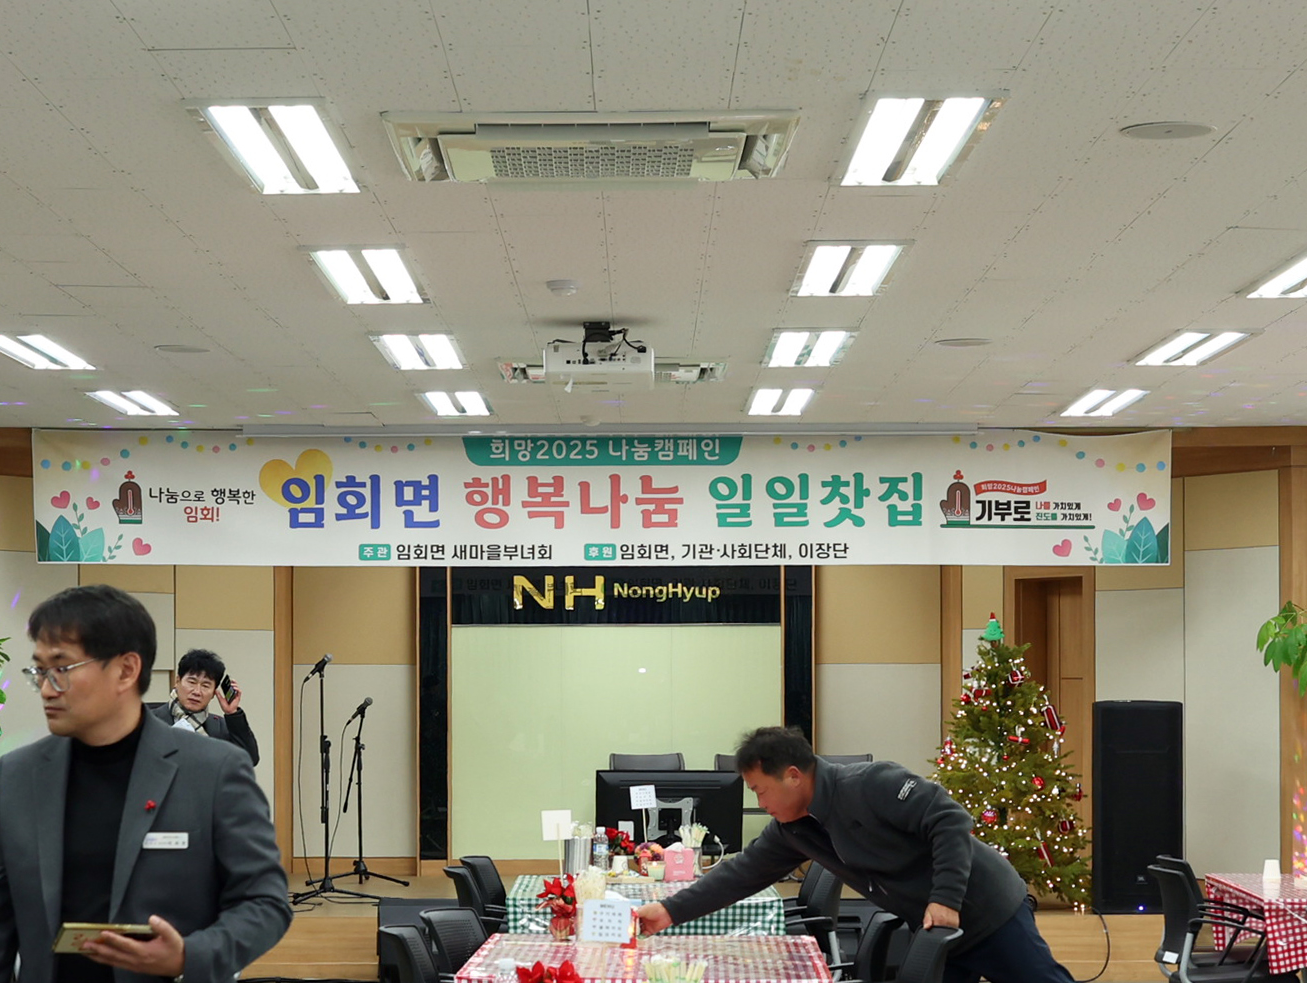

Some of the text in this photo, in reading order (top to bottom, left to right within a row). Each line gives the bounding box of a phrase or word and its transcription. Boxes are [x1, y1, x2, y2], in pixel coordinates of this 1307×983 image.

[490, 438, 720, 461] 희망2025 나눔캠페인
[149, 487, 256, 505] 나눔으로 행복한
[281, 471, 924, 530] 임회면 행복나눔 일일찻집
[183, 505, 220, 523] 임회!
[975, 499, 1032, 522] 기부로
[1053, 501, 1081, 511] 가치있게
[396, 544, 446, 561] 임회면
[451, 544, 553, 561] 새마을부녀회
[619, 543, 675, 561] 임회면,
[798, 543, 850, 560] 이장단
[513, 575, 605, 611] NH
[613, 582, 721, 602] NongHyup
